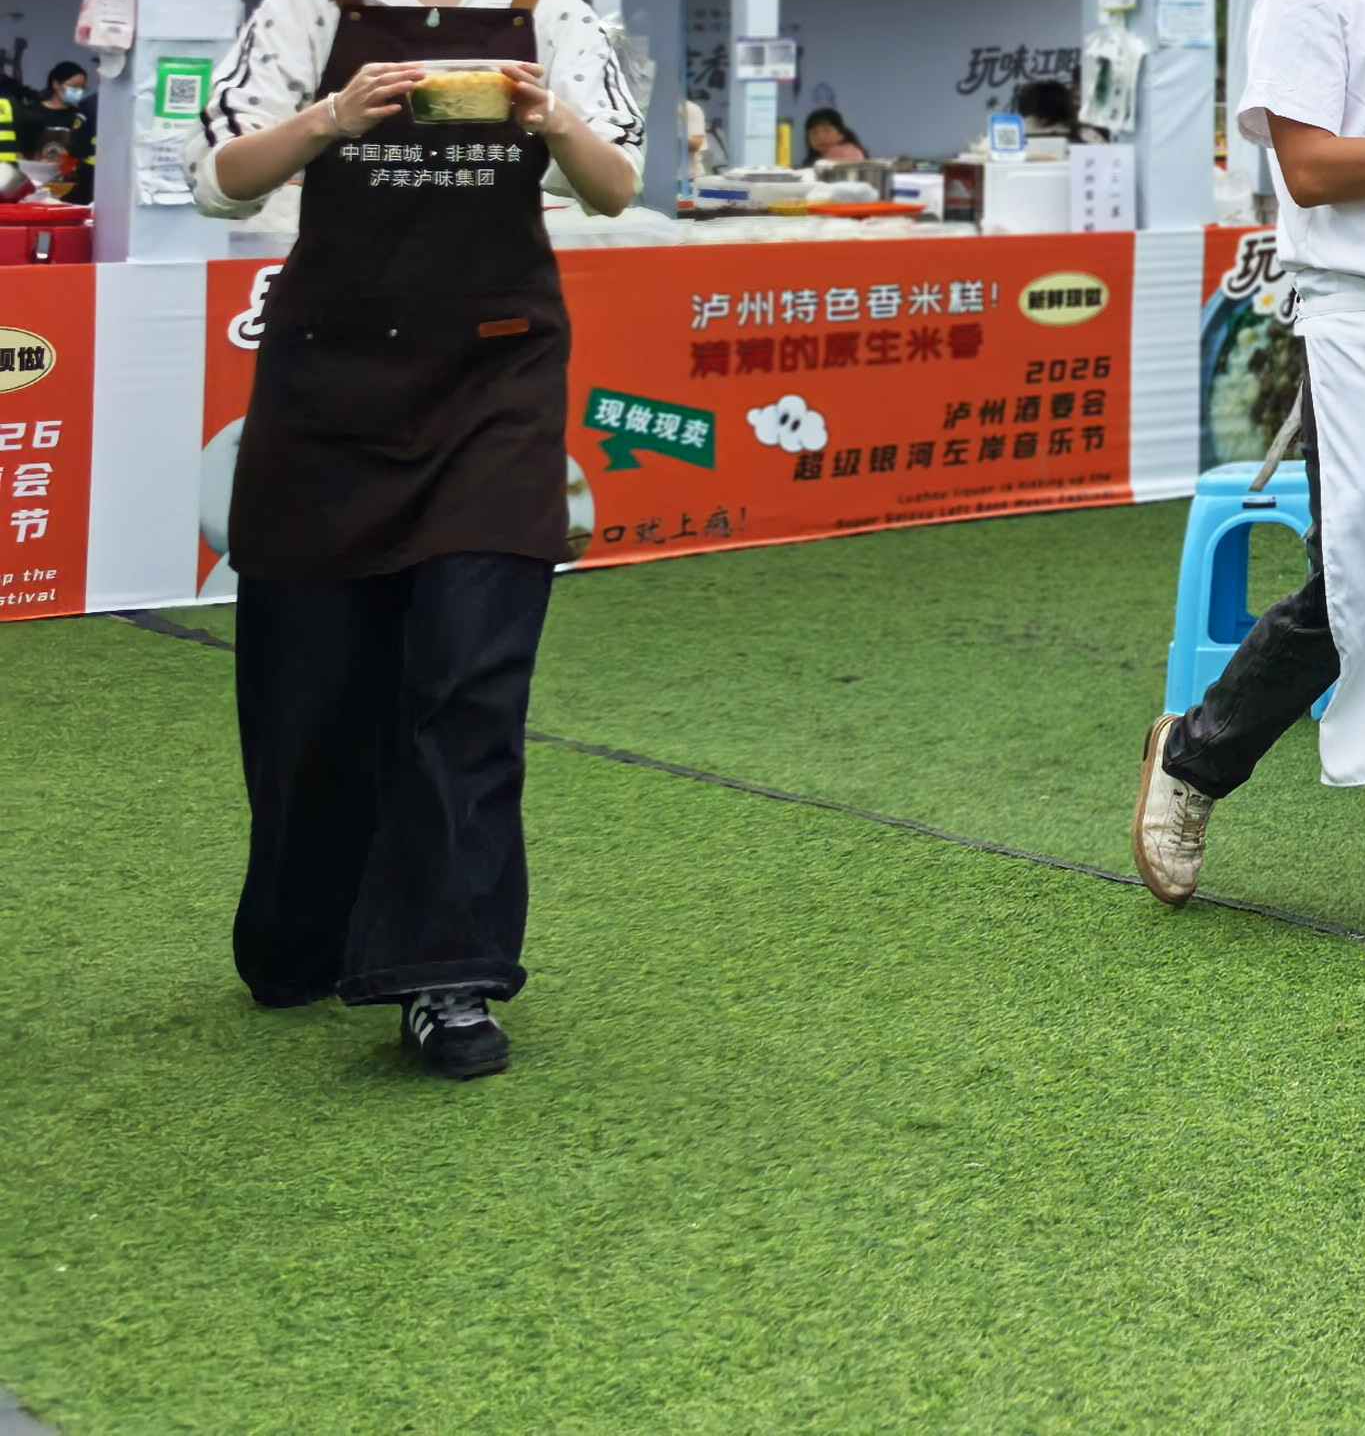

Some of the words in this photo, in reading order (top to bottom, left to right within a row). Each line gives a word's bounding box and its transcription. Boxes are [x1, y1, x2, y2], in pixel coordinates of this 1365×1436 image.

[370, 168, 495, 187] 泸菜泸味集团
[690, 279, 999, 330] 泸州特色香米糕!
[1025, 355, 1112, 385] 2026
[594, 397, 710, 449] 现做现卖
[793, 425, 1106, 482] 超级银河左岸音乐节
[0, 462, 53, 498] 会
[23, 568, 57, 582] the
